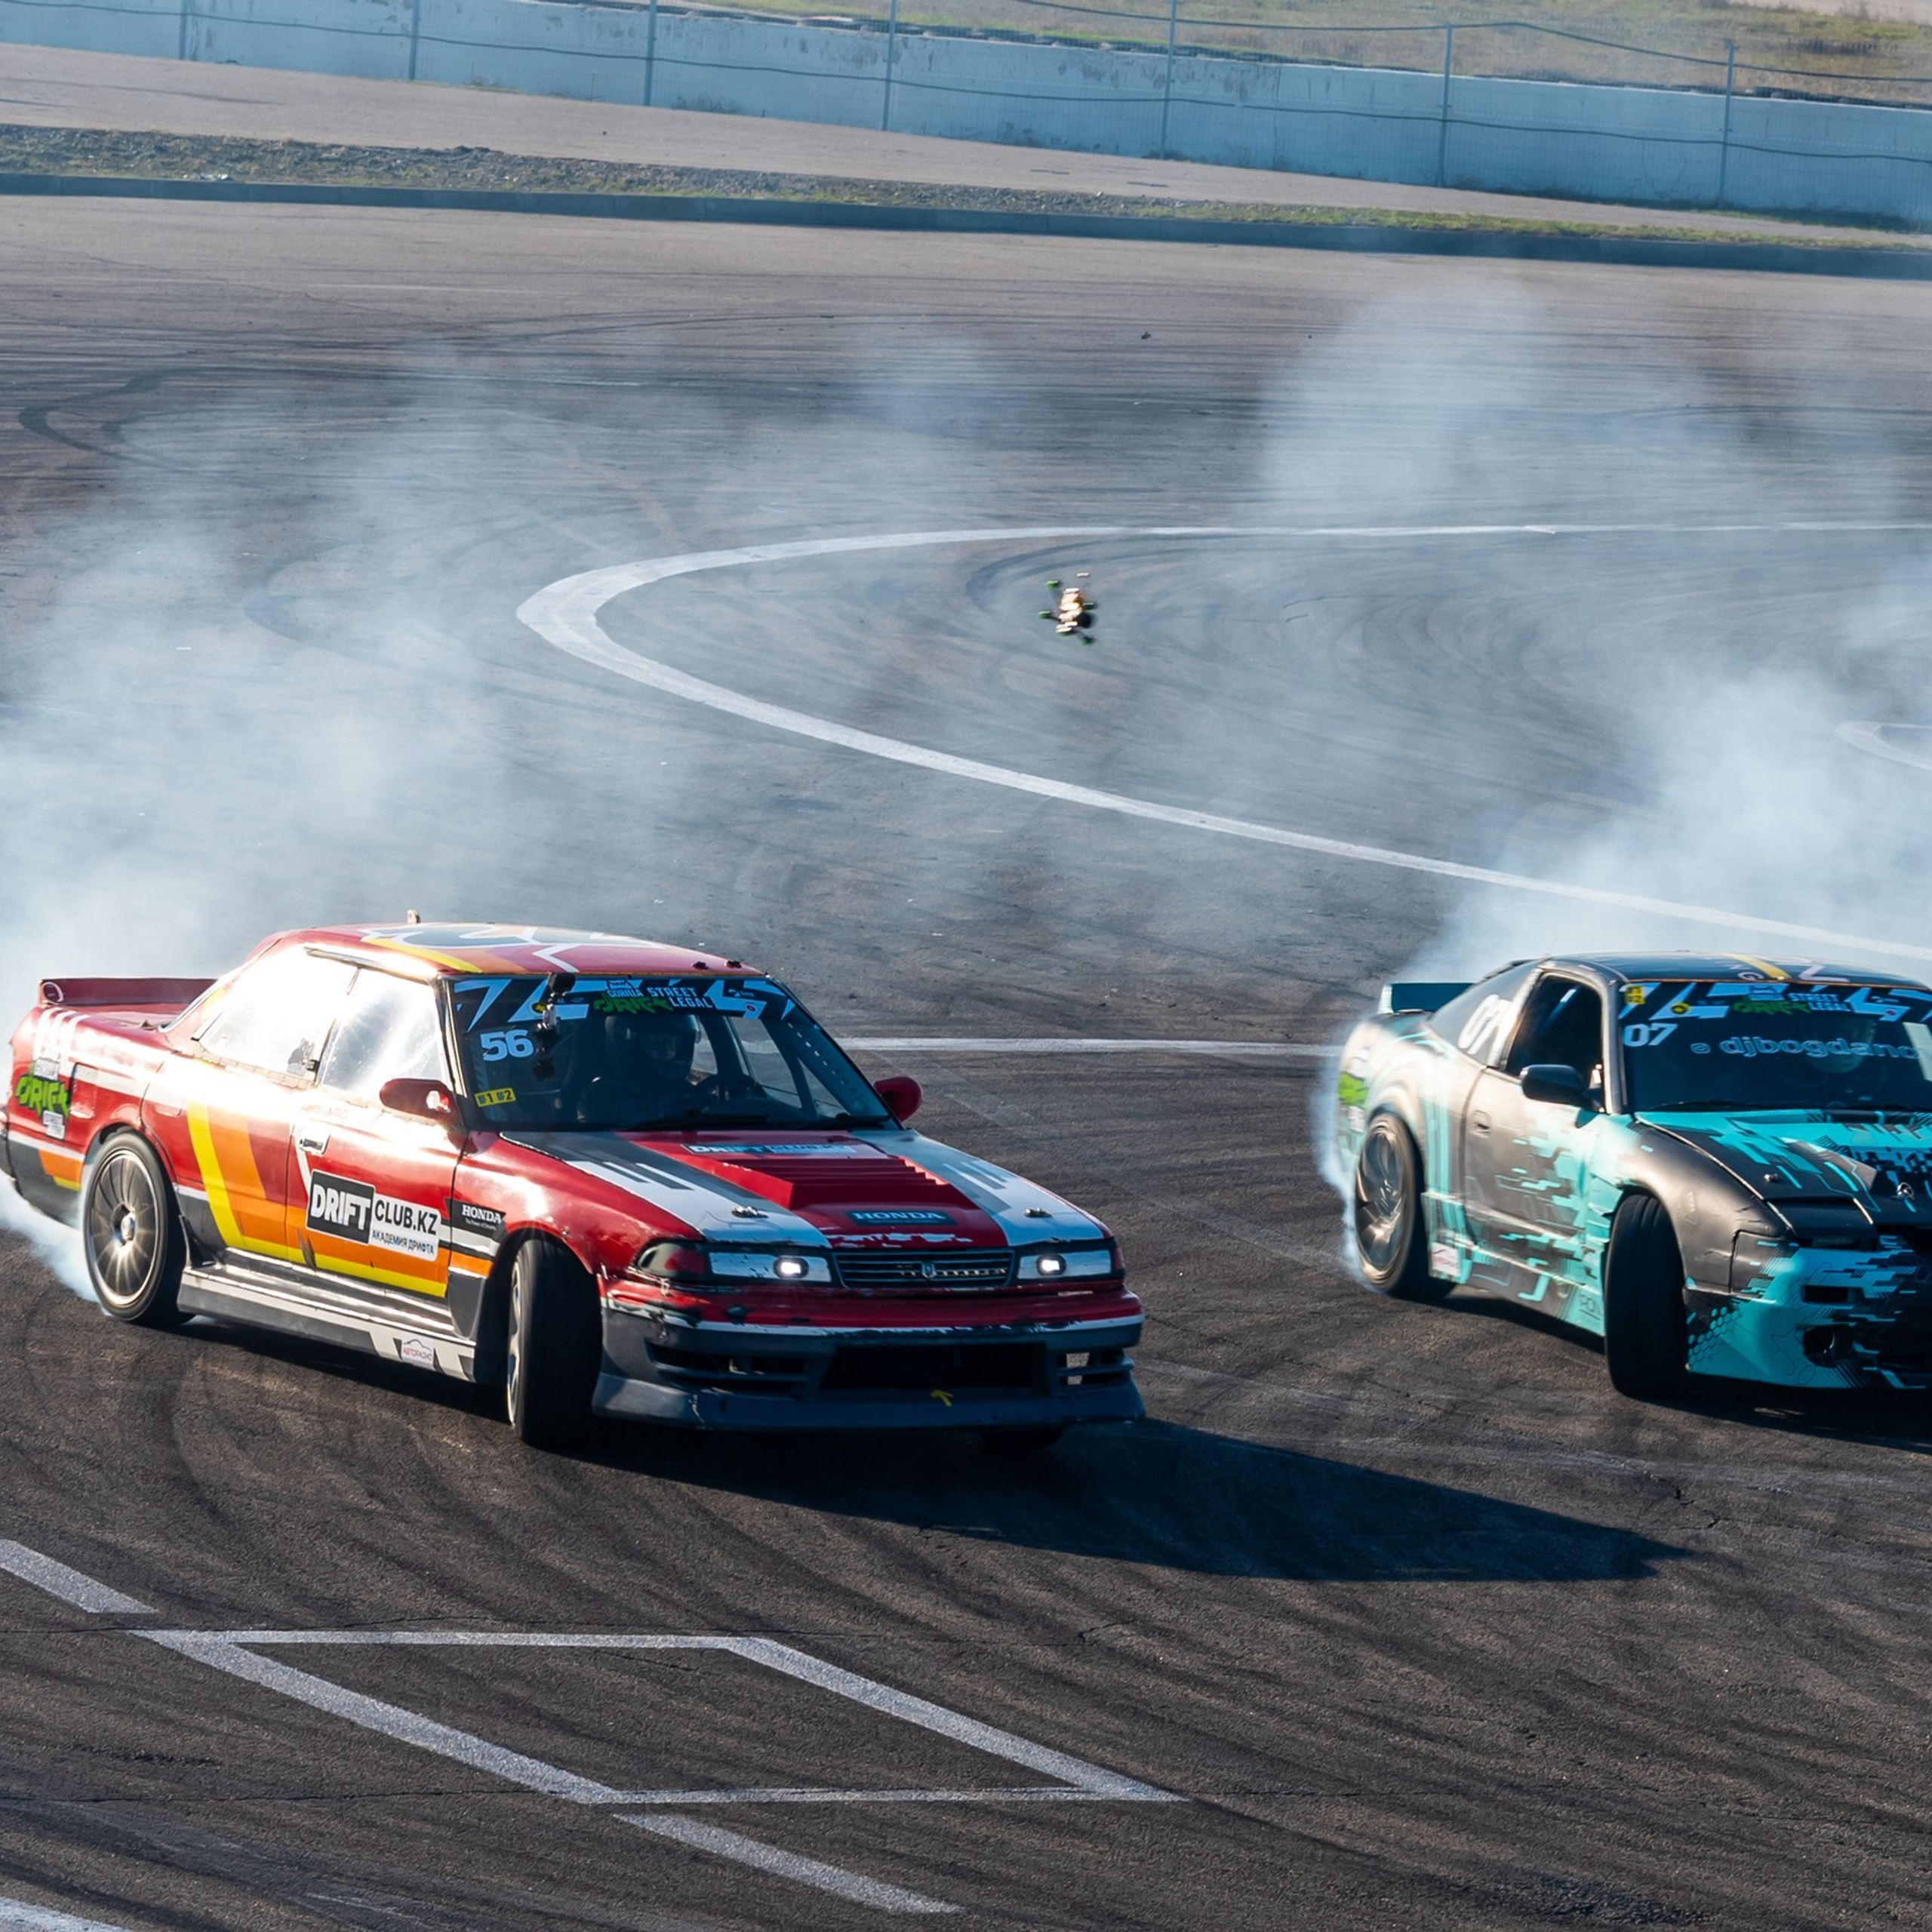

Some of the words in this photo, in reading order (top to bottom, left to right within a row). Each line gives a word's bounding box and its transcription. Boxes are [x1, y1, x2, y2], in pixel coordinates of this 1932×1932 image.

[647, 987, 698, 997] STREET
[669, 996, 713, 1008] LEGAL
[480, 1029, 534, 1062] 56
[1623, 1023, 1678, 1048] 07
[310, 1183, 371, 1230] DRIFT
[461, 1204, 503, 1224] HONDA
[851, 1212, 946, 1220] HONDA
[374, 1199, 438, 1235] CLUB.KZ
[408, 1238, 435, 1255] ДРИФТА
